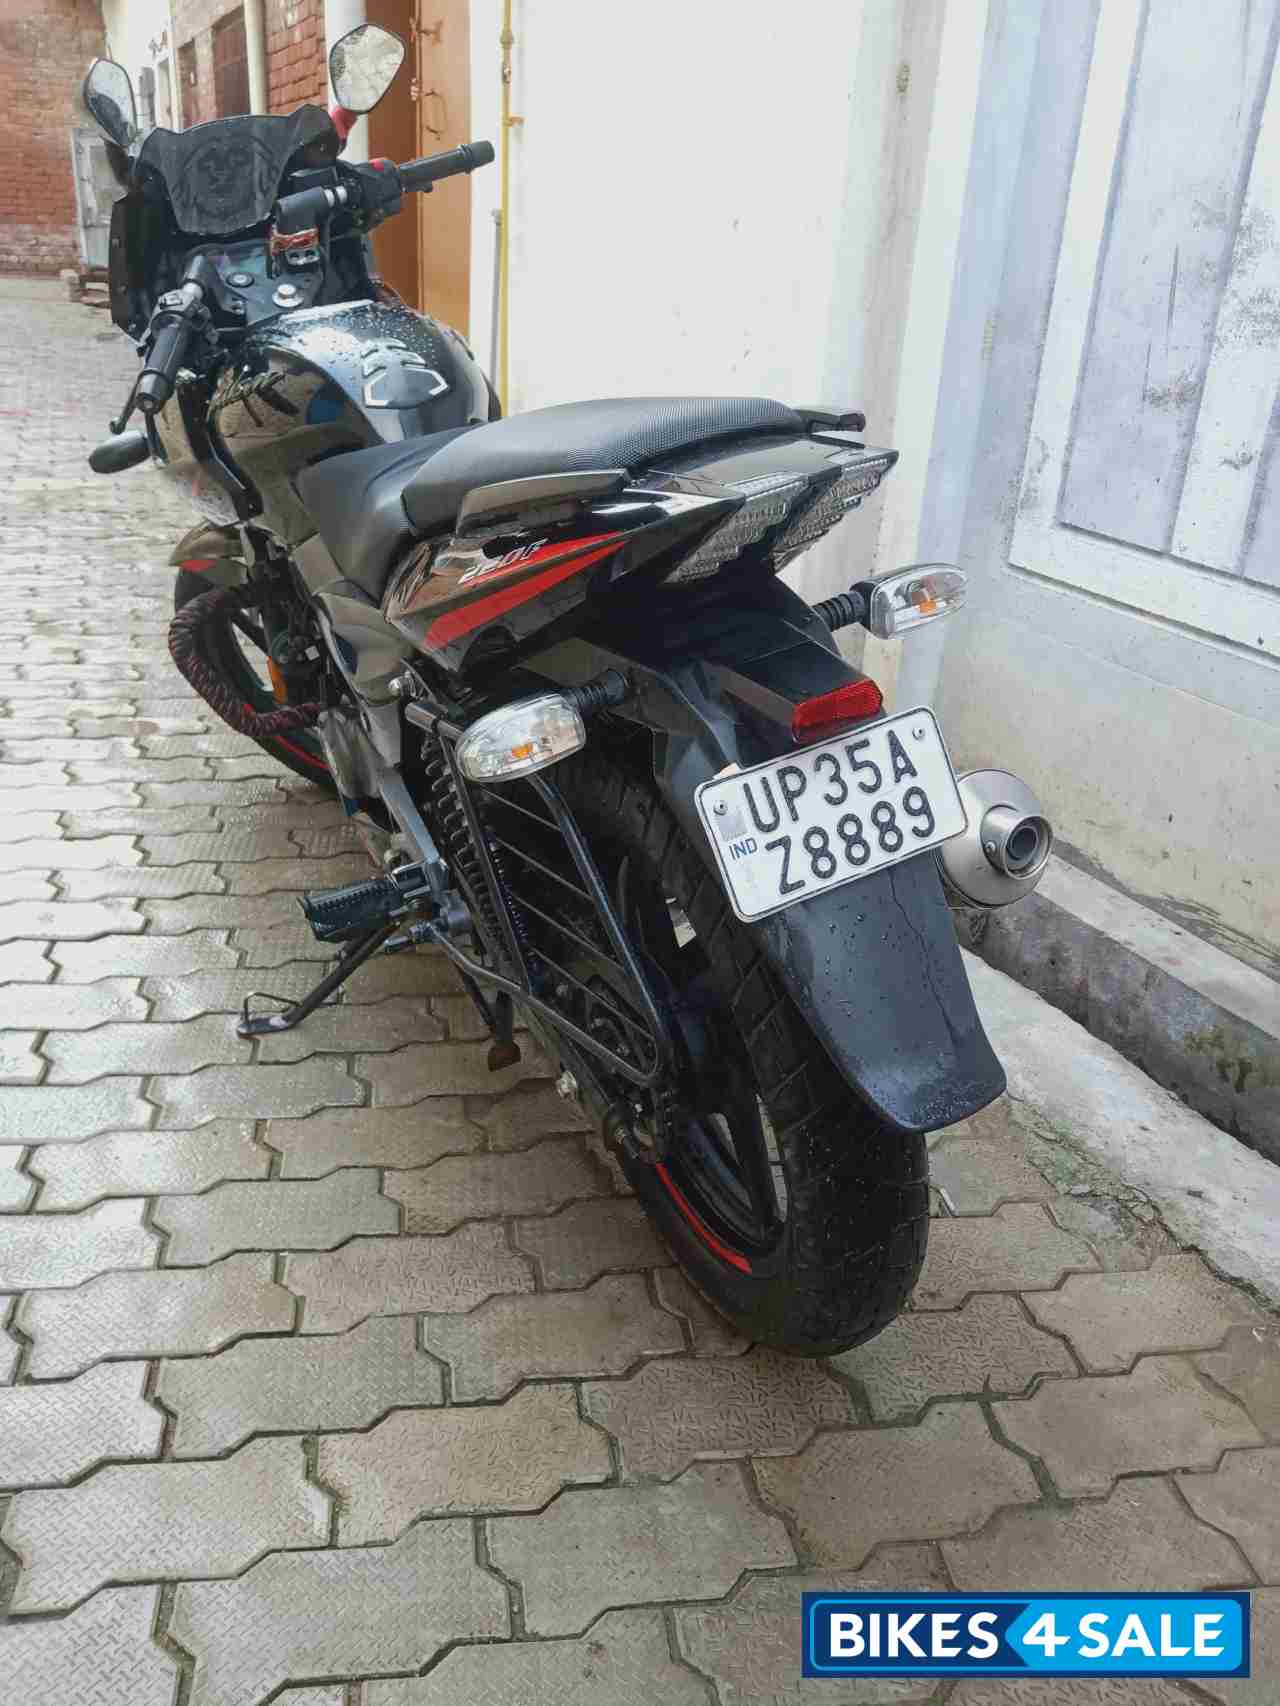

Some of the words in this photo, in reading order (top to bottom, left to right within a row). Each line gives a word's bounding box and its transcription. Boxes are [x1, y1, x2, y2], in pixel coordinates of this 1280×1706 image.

[743, 730, 917, 833] UP35A
[728, 837, 758, 861] IND
[764, 785, 936, 895] Z8889
